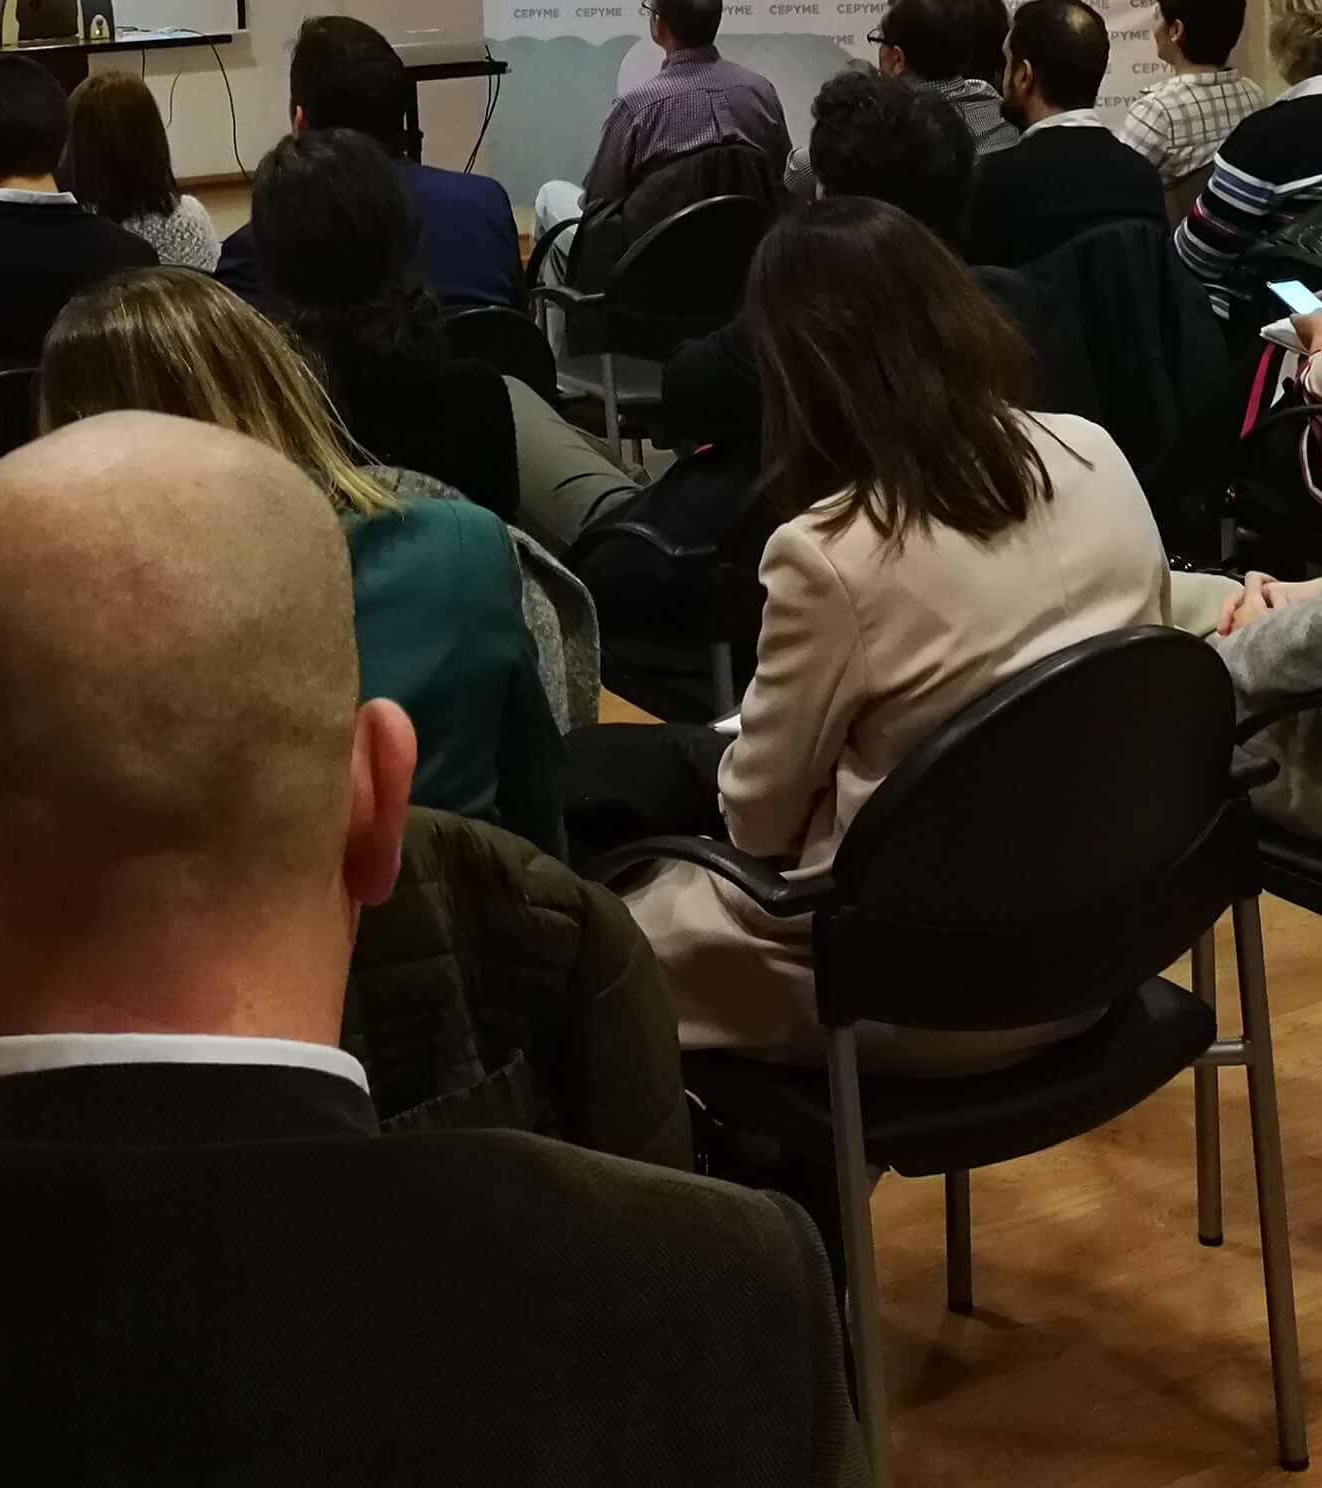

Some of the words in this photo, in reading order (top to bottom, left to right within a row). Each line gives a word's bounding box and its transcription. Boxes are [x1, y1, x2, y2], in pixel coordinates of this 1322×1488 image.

[513, 8, 560, 19] CEPYME
[575, 7, 622, 18] CEPYME
[769, 4, 820, 15] CEPYME
